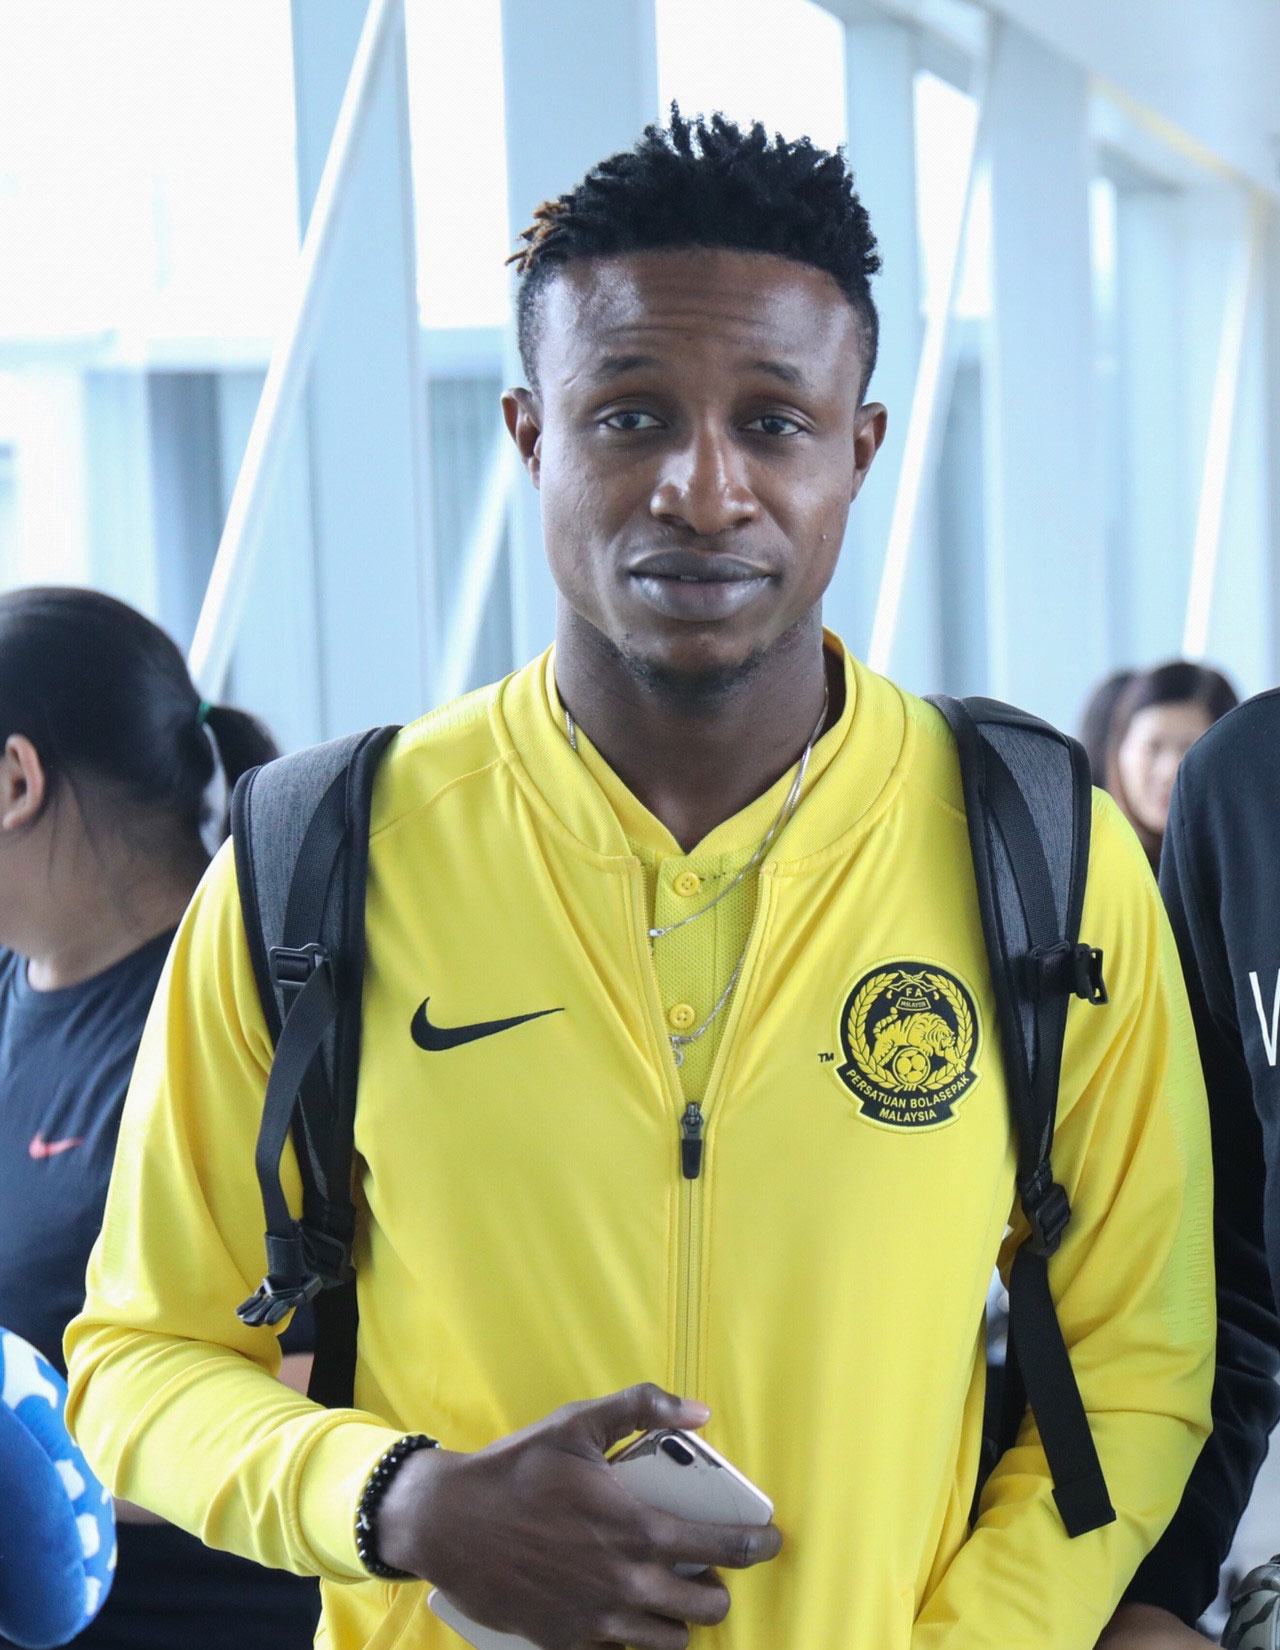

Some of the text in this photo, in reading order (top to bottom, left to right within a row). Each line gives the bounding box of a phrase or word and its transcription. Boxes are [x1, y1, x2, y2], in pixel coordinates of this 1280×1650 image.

[846, 1069, 970, 1109] PERSATUAN BOLASEPAK
[879, 1108, 937, 1122] MALAYSIA
